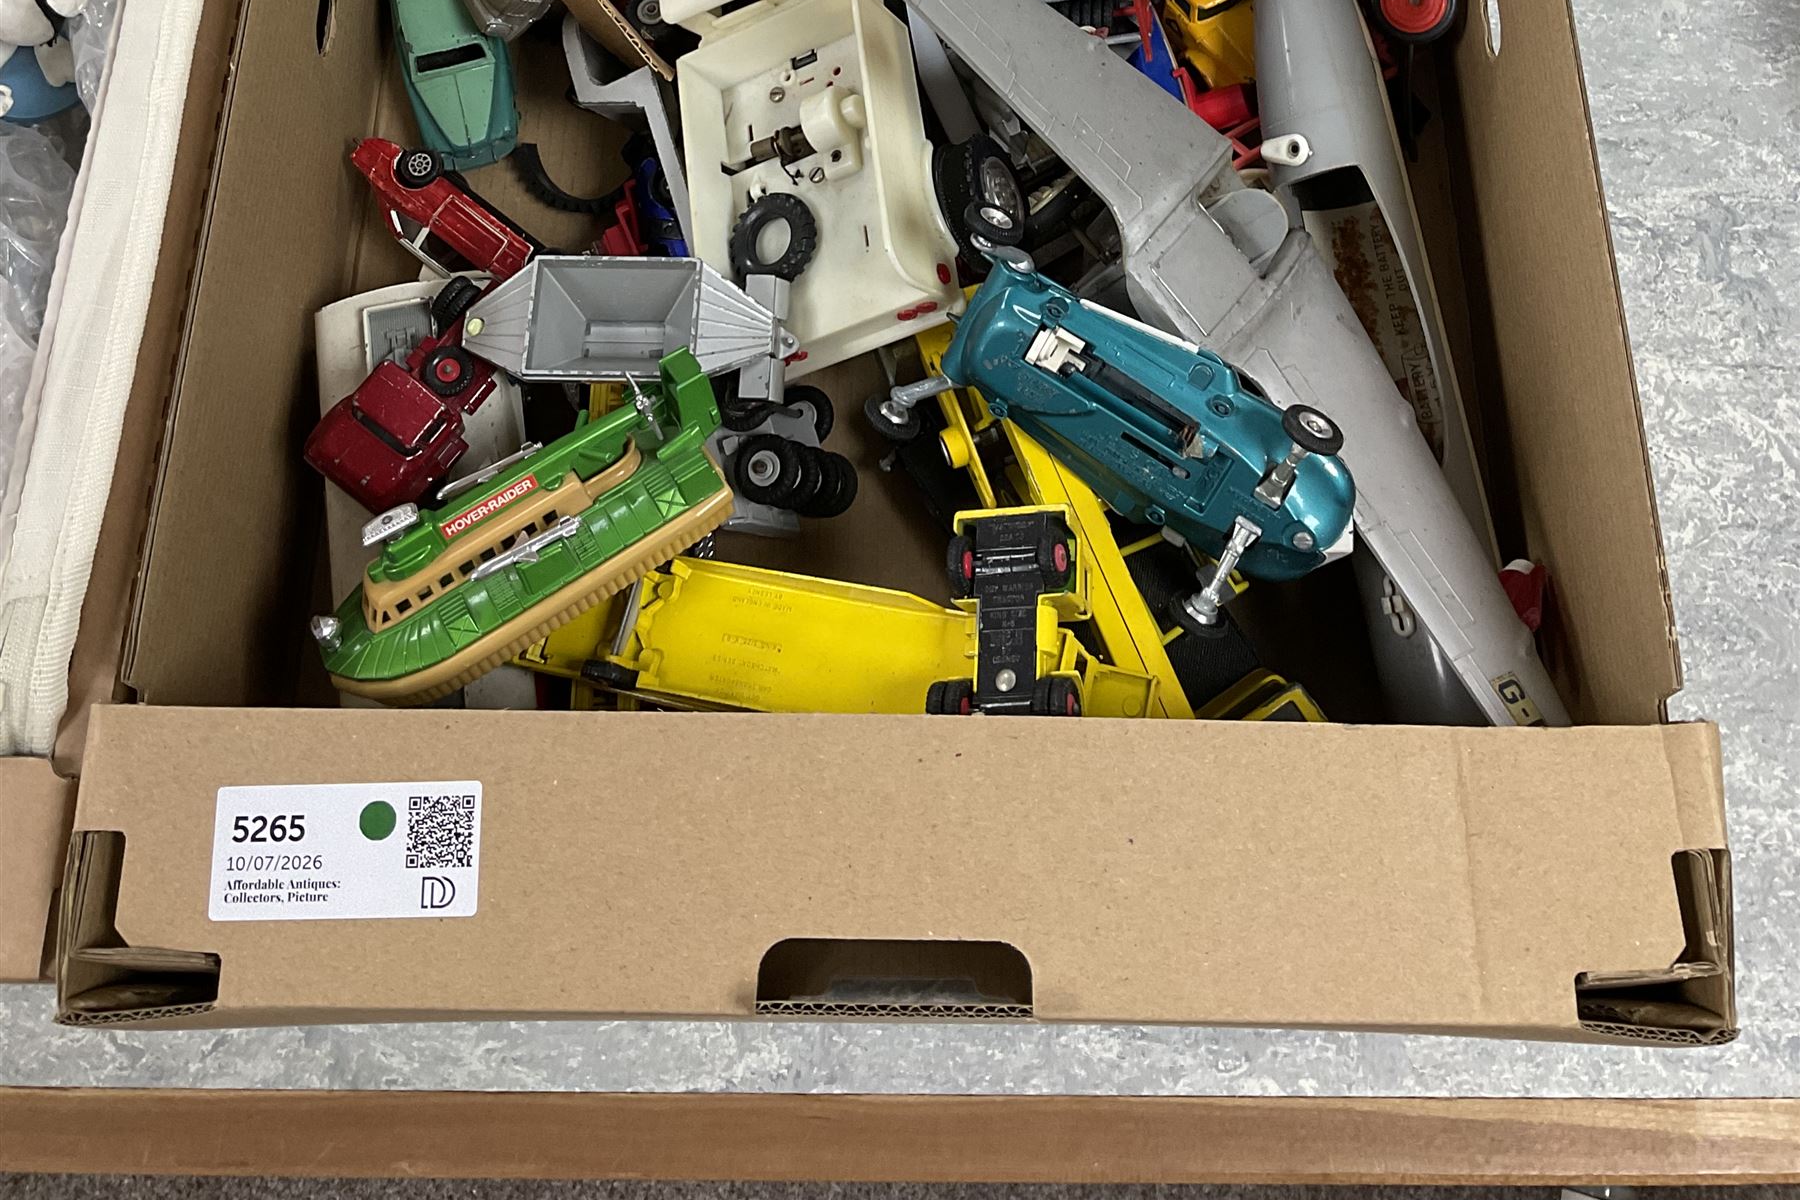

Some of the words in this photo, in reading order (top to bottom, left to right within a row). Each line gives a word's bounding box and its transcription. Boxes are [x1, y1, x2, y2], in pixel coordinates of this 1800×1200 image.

[1368, 222, 1389, 272] BATTERY
[1380, 274, 1396, 299] THE
[1387, 301, 1408, 337] KEEP
[445, 479, 533, 536] HOVER-RAIDER
[232, 815, 305, 843] 5265
[226, 855, 323, 871] 10/07/2026
[224, 879, 285, 891] Affordable
[287, 879, 341, 891] Antiques:
[224, 892, 284, 904] Collectors,
[287, 891, 329, 902] Picture
